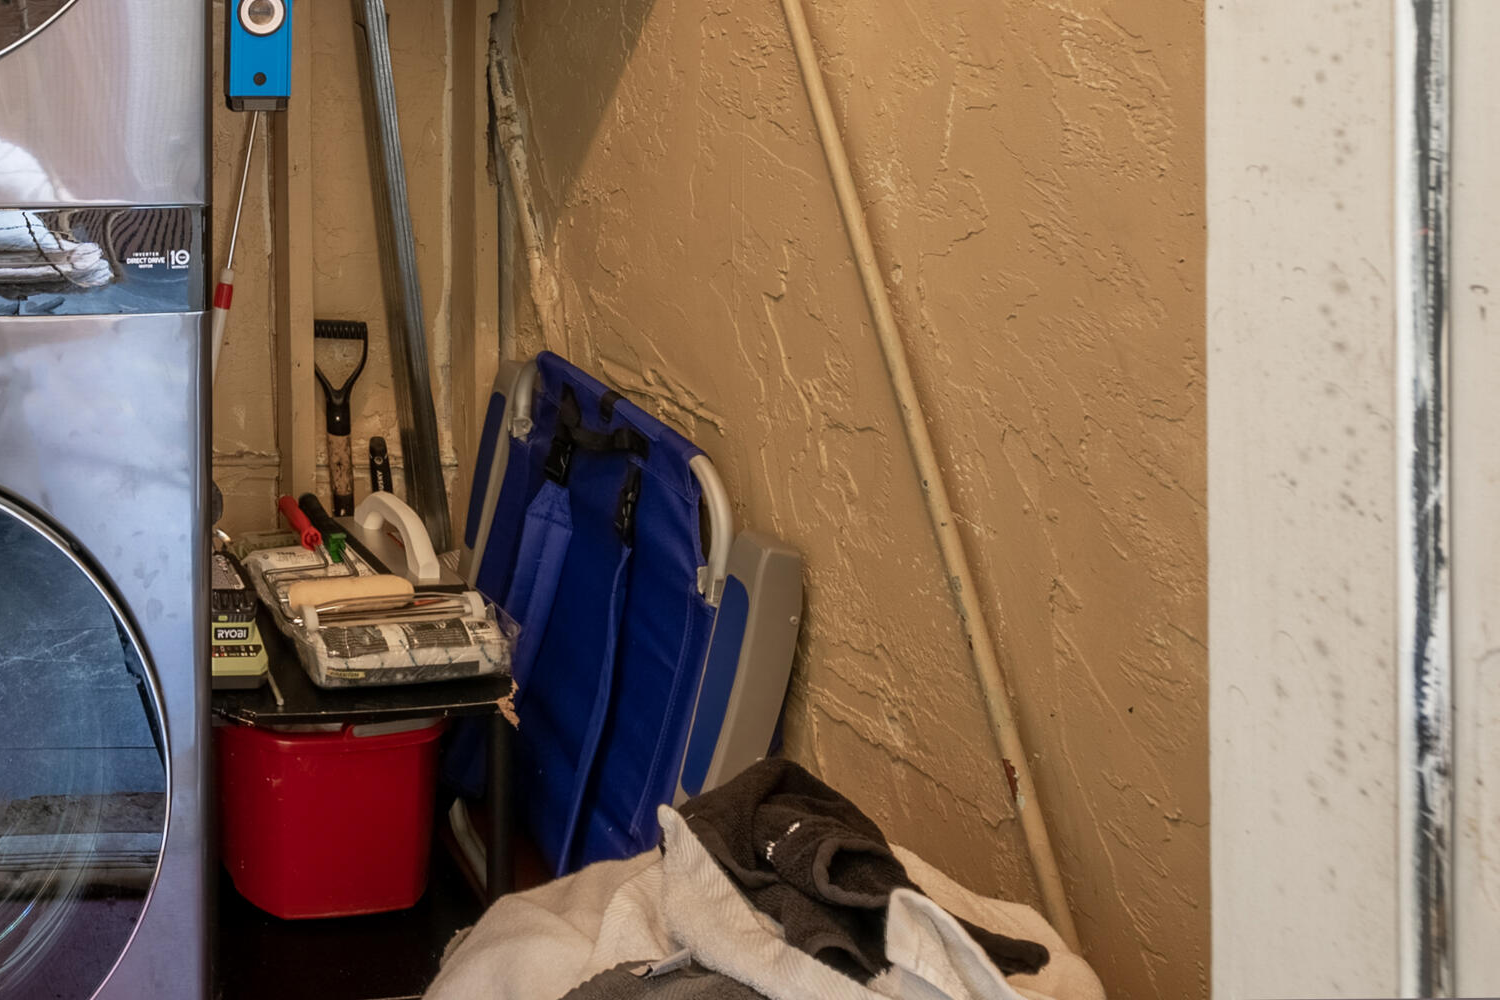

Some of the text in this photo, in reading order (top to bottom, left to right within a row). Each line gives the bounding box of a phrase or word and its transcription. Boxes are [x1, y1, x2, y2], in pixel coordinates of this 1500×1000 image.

[148, 256, 165, 264] DRIVE
[170, 249, 190, 265] 10
[217, 629, 247, 639] RYOBI
